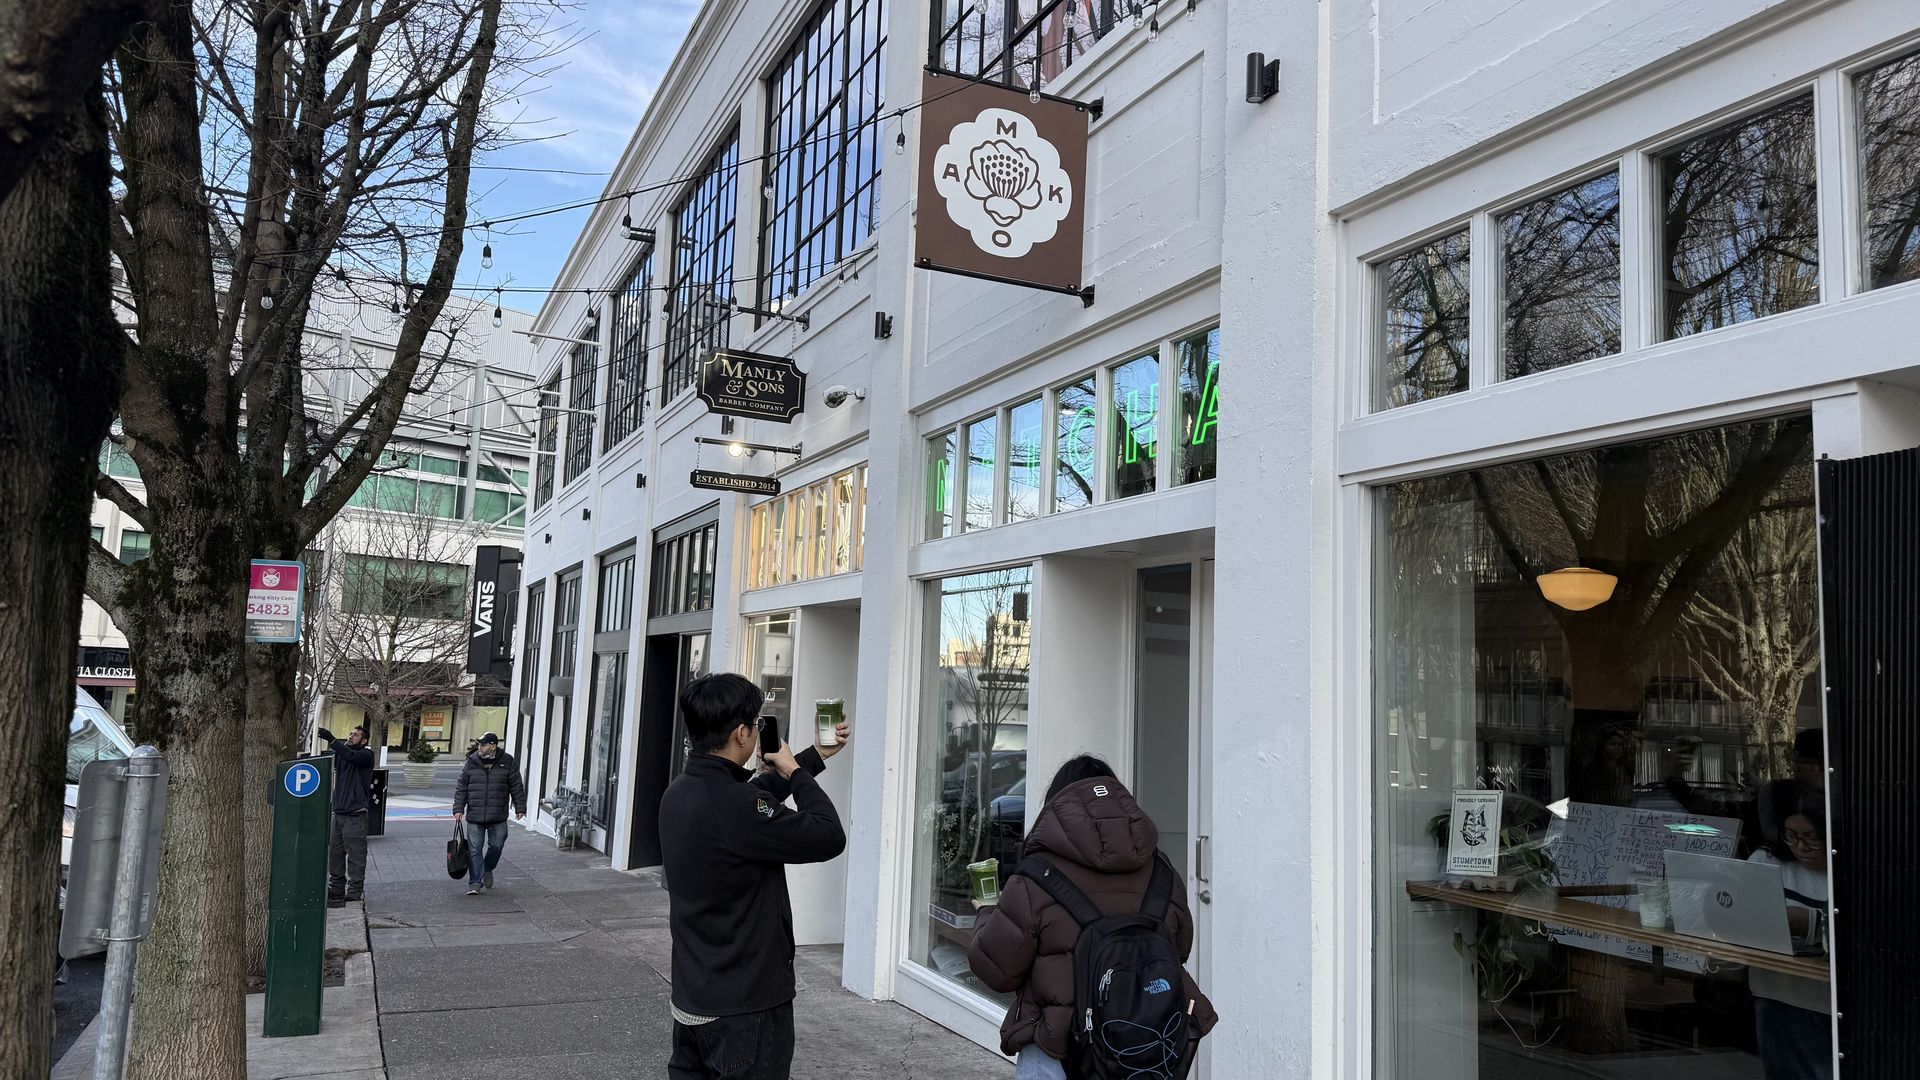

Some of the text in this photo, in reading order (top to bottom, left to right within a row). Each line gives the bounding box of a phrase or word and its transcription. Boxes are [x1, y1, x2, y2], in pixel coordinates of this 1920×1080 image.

[721, 359, 787, 382] MANLY
[726, 380, 785, 398] & SONS
[719, 398, 785, 412] BARBER COMPANY
[696, 475, 776, 491] ESTABLISHED 2014
[248, 604, 290, 616] 54823
[474, 580, 495, 638] VANS
[295, 769, 312, 792] P
[1631, 810, 1654, 827] TEA
[1452, 856, 1493, 866] STUMPTOWN
